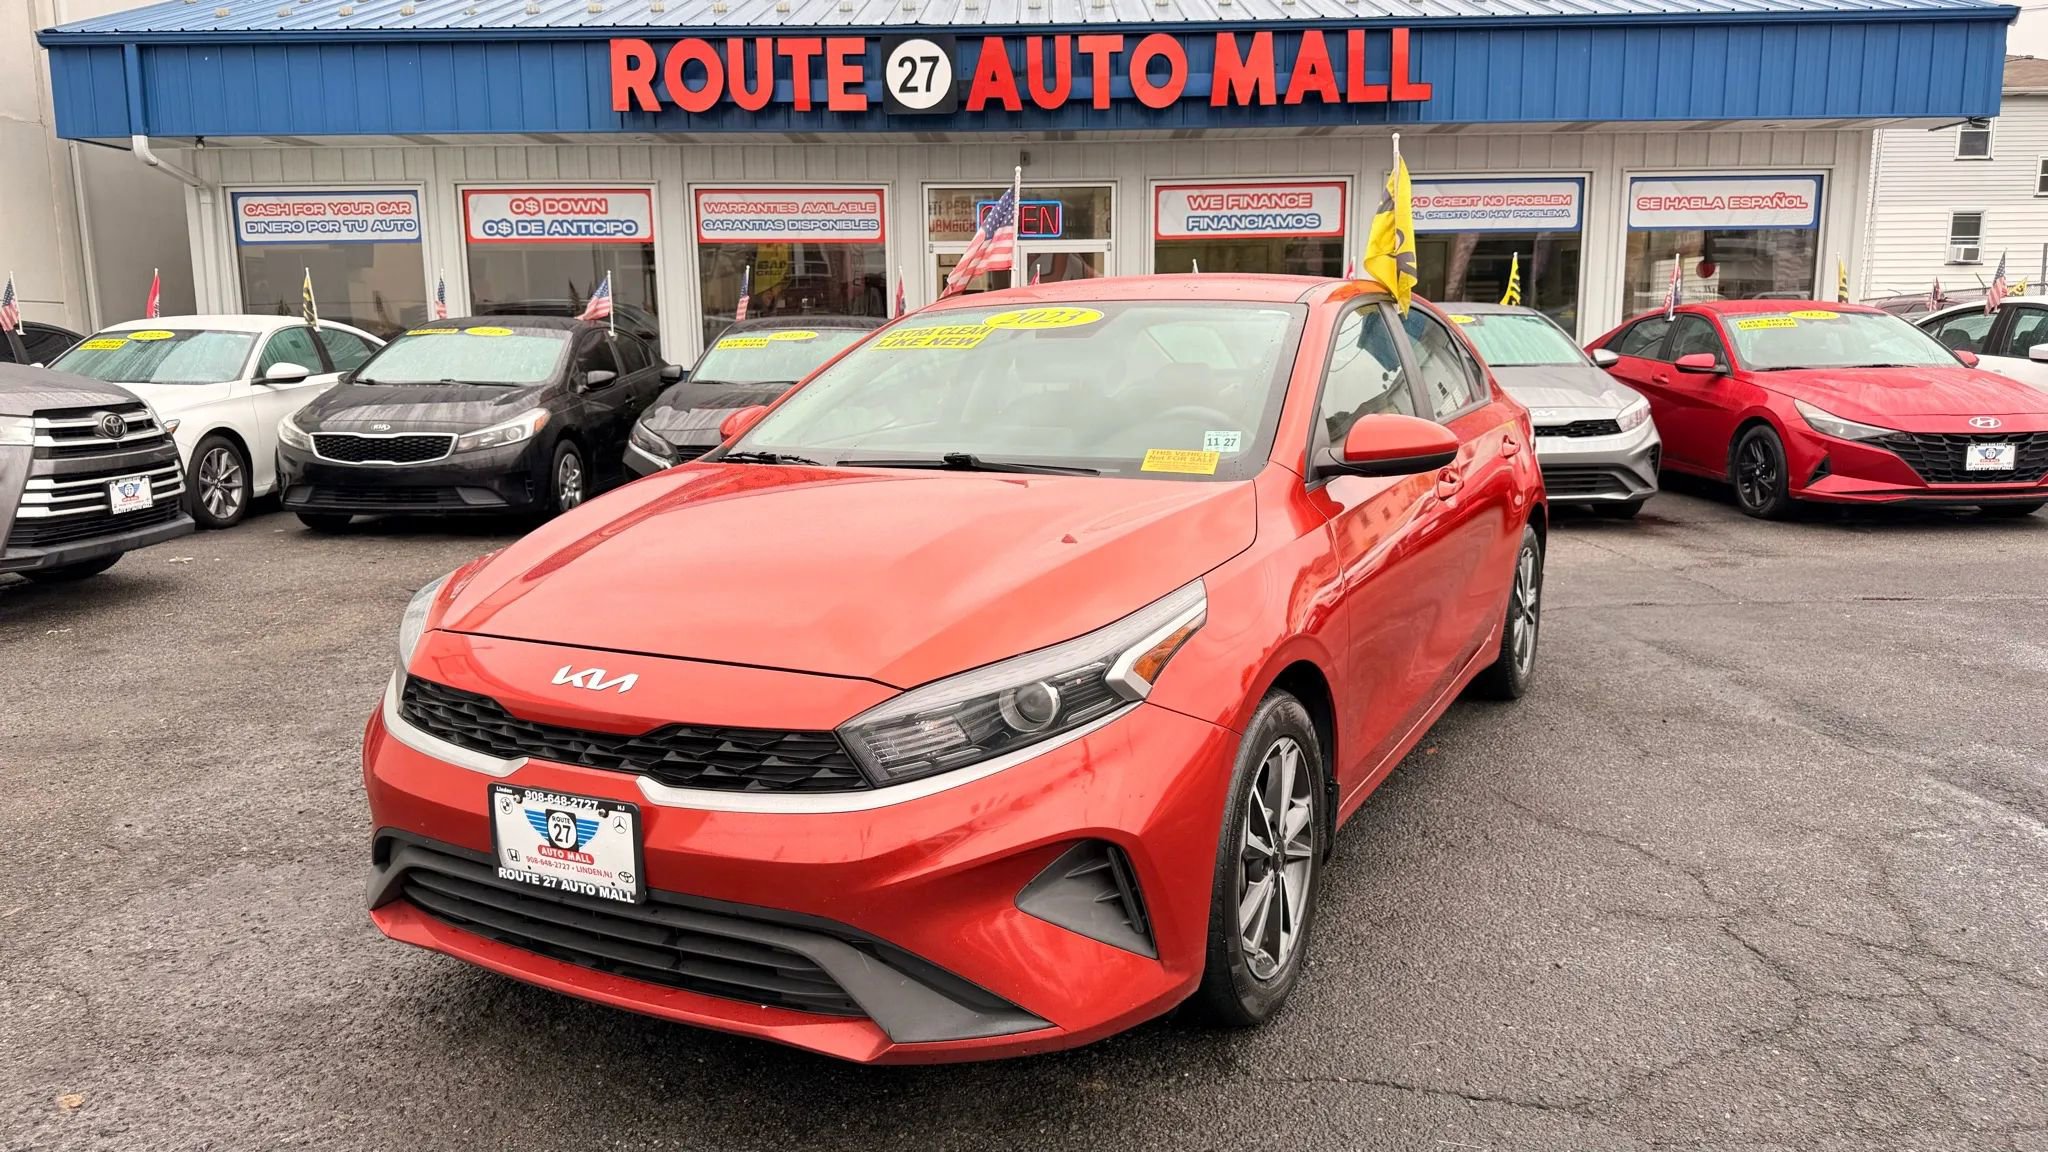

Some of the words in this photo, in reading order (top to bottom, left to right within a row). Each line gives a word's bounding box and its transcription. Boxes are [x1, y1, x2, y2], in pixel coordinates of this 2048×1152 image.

[610, 37, 868, 113] ROUTE
[897, 54, 941, 94] 27
[965, 32, 1188, 112] AUTO
[1210, 28, 1433, 107] MALL
[544, 198, 608, 214] DOWN
[704, 202, 799, 214] WARRANTIES
[801, 202, 876, 213] AVAILABLE
[1187, 195, 1224, 210] WE
[1227, 193, 1312, 209] FINANCE
[1411, 196, 1431, 208] AD
[1433, 196, 1481, 207] CREDIT
[1483, 196, 1505, 207] NO
[1506, 195, 1572, 206] PROBLEM
[1637, 197, 1662, 210] SE
[1664, 196, 1725, 210] HABLA
[1728, 192, 1808, 209] ESPAÑOL
[244, 203, 291, 216] CASH
[293, 203, 326, 215] FOR
[329, 202, 374, 215] YOUR
[377, 202, 412, 214] CAR
[1426, 210, 1469, 219] CREDITO
[1471, 210, 1488, 218] NO
[1489, 210, 1512, 218] HAY
[1513, 209, 1570, 218] PROBLEMA
[246, 220, 304, 234] DINERO
[307, 220, 341, 233] POR
[343, 220, 367, 232] TU
[371, 219, 417, 231] AUTO
[516, 220, 545, 235] DE
[547, 219, 638, 236] ANTICIPO
[702, 219, 785, 231] GARANTIAS
[788, 219, 880, 231] DISPONIBLES
[1187, 213, 1321, 231] FINANCIAMOS
[999, 310, 1087, 325] 2023
[886, 328, 934, 339] EXTRA
[936, 326, 993, 337] CLEAN
[878, 338, 924, 348] LIKE
[928, 336, 981, 347] NEW
[1207, 438, 1219, 446] 11
[1224, 438, 1236, 446] 27
[525, 790, 599, 811] 908-648-2727
[551, 816, 571, 825] ROUTE
[553, 823, 571, 844] 27
[526, 855, 570, 871] 908-648-2727
[541, 849, 565, 859] AUTO
[567, 853, 592, 864] MALL
[499, 867, 541, 885] ROUTE
[543, 876, 557, 888] 27
[561, 879, 596, 896] AUTO
[599, 886, 636, 904] MALL
